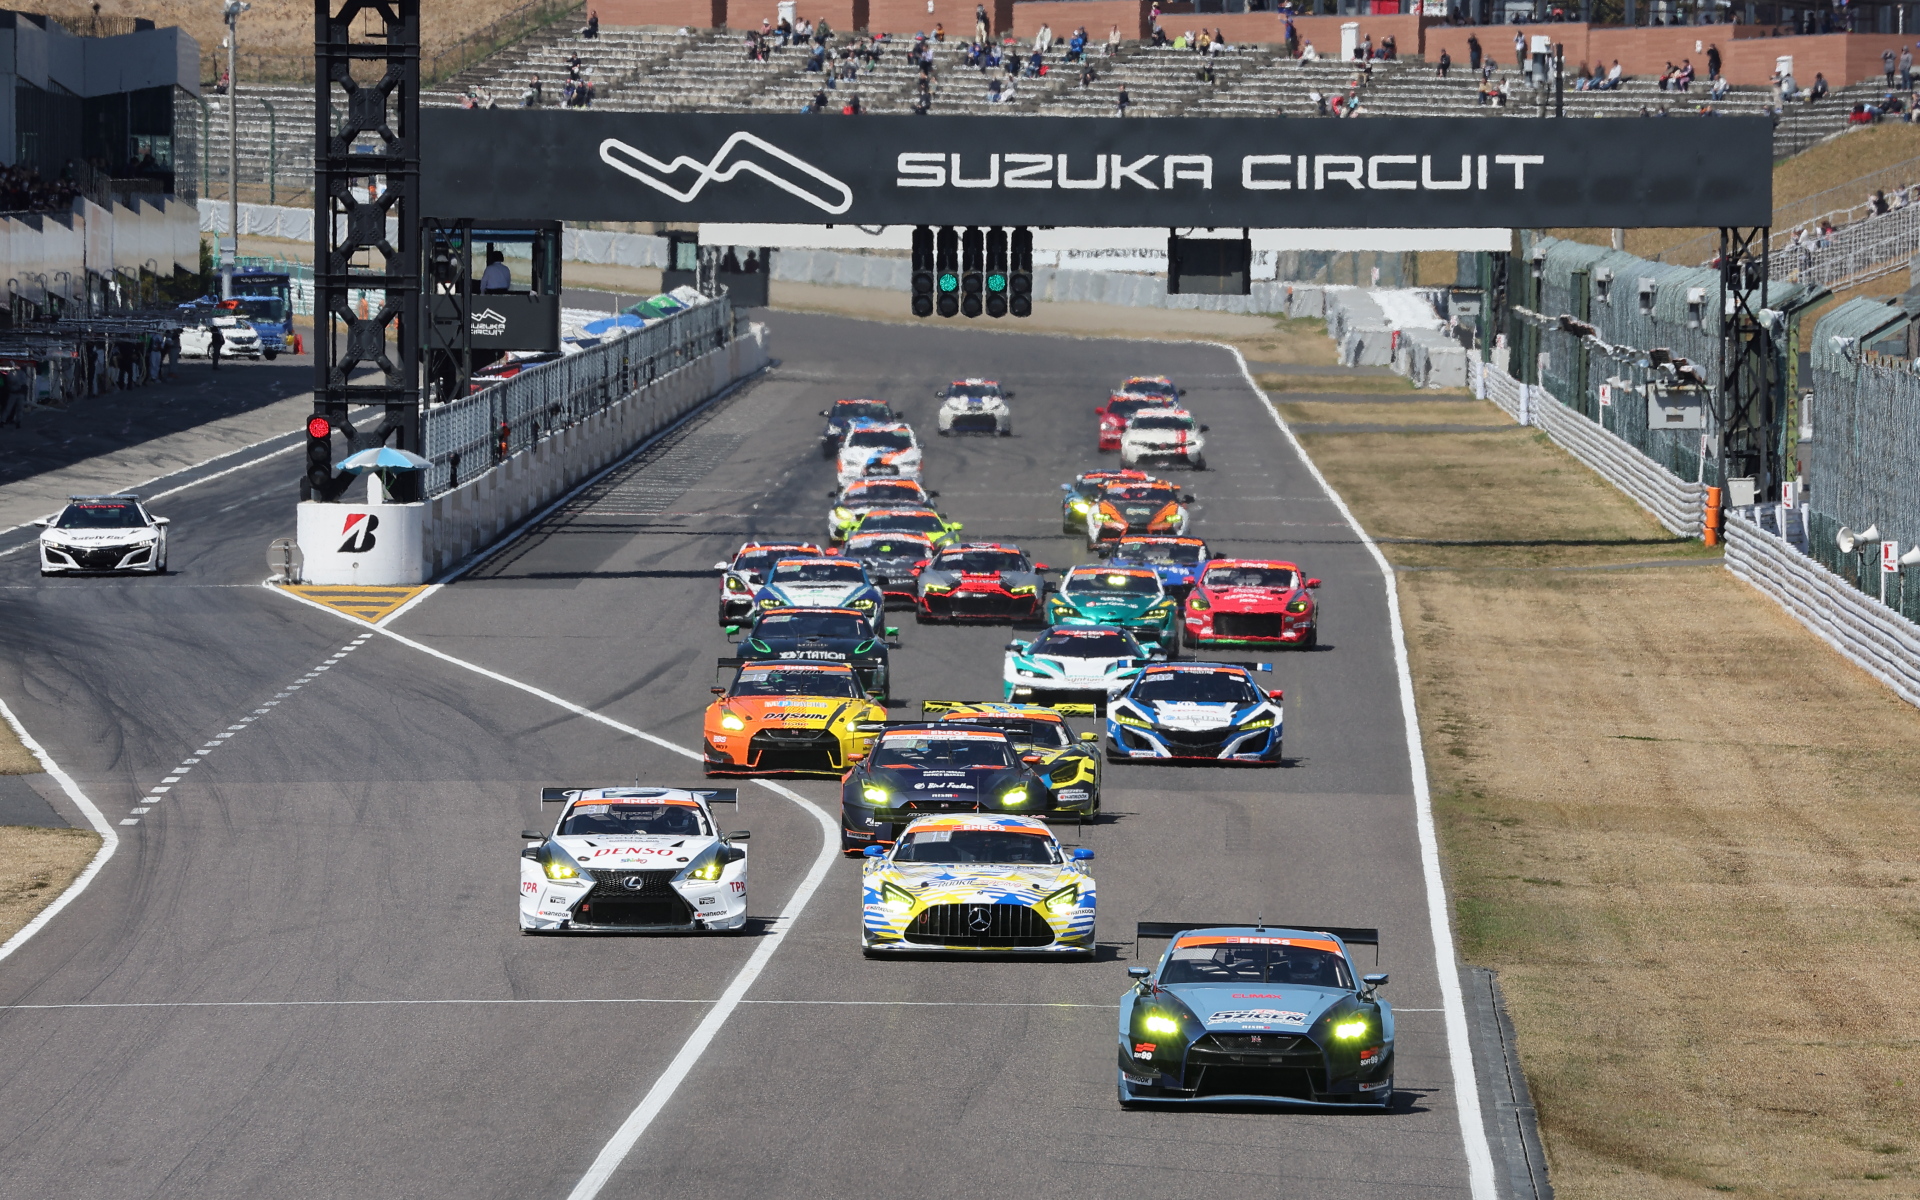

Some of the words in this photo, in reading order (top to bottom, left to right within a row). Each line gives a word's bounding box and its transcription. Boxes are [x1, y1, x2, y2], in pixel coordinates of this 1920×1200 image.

[896, 152, 1213, 190] SUZUKA
[1241, 154, 1545, 190] CIRCUIT
[763, 713, 828, 721] DAISHIN
[947, 781, 975, 790] Feather
[963, 824, 1006, 832] ENEOS
[594, 847, 674, 857] DENSO
[522, 881, 538, 894] TPR
[729, 881, 746, 893] TPR
[938, 879, 974, 888] ROOKIE
[1239, 937, 1291, 946] ENEOS
[1208, 1011, 1305, 1022] 5ZIGEN
